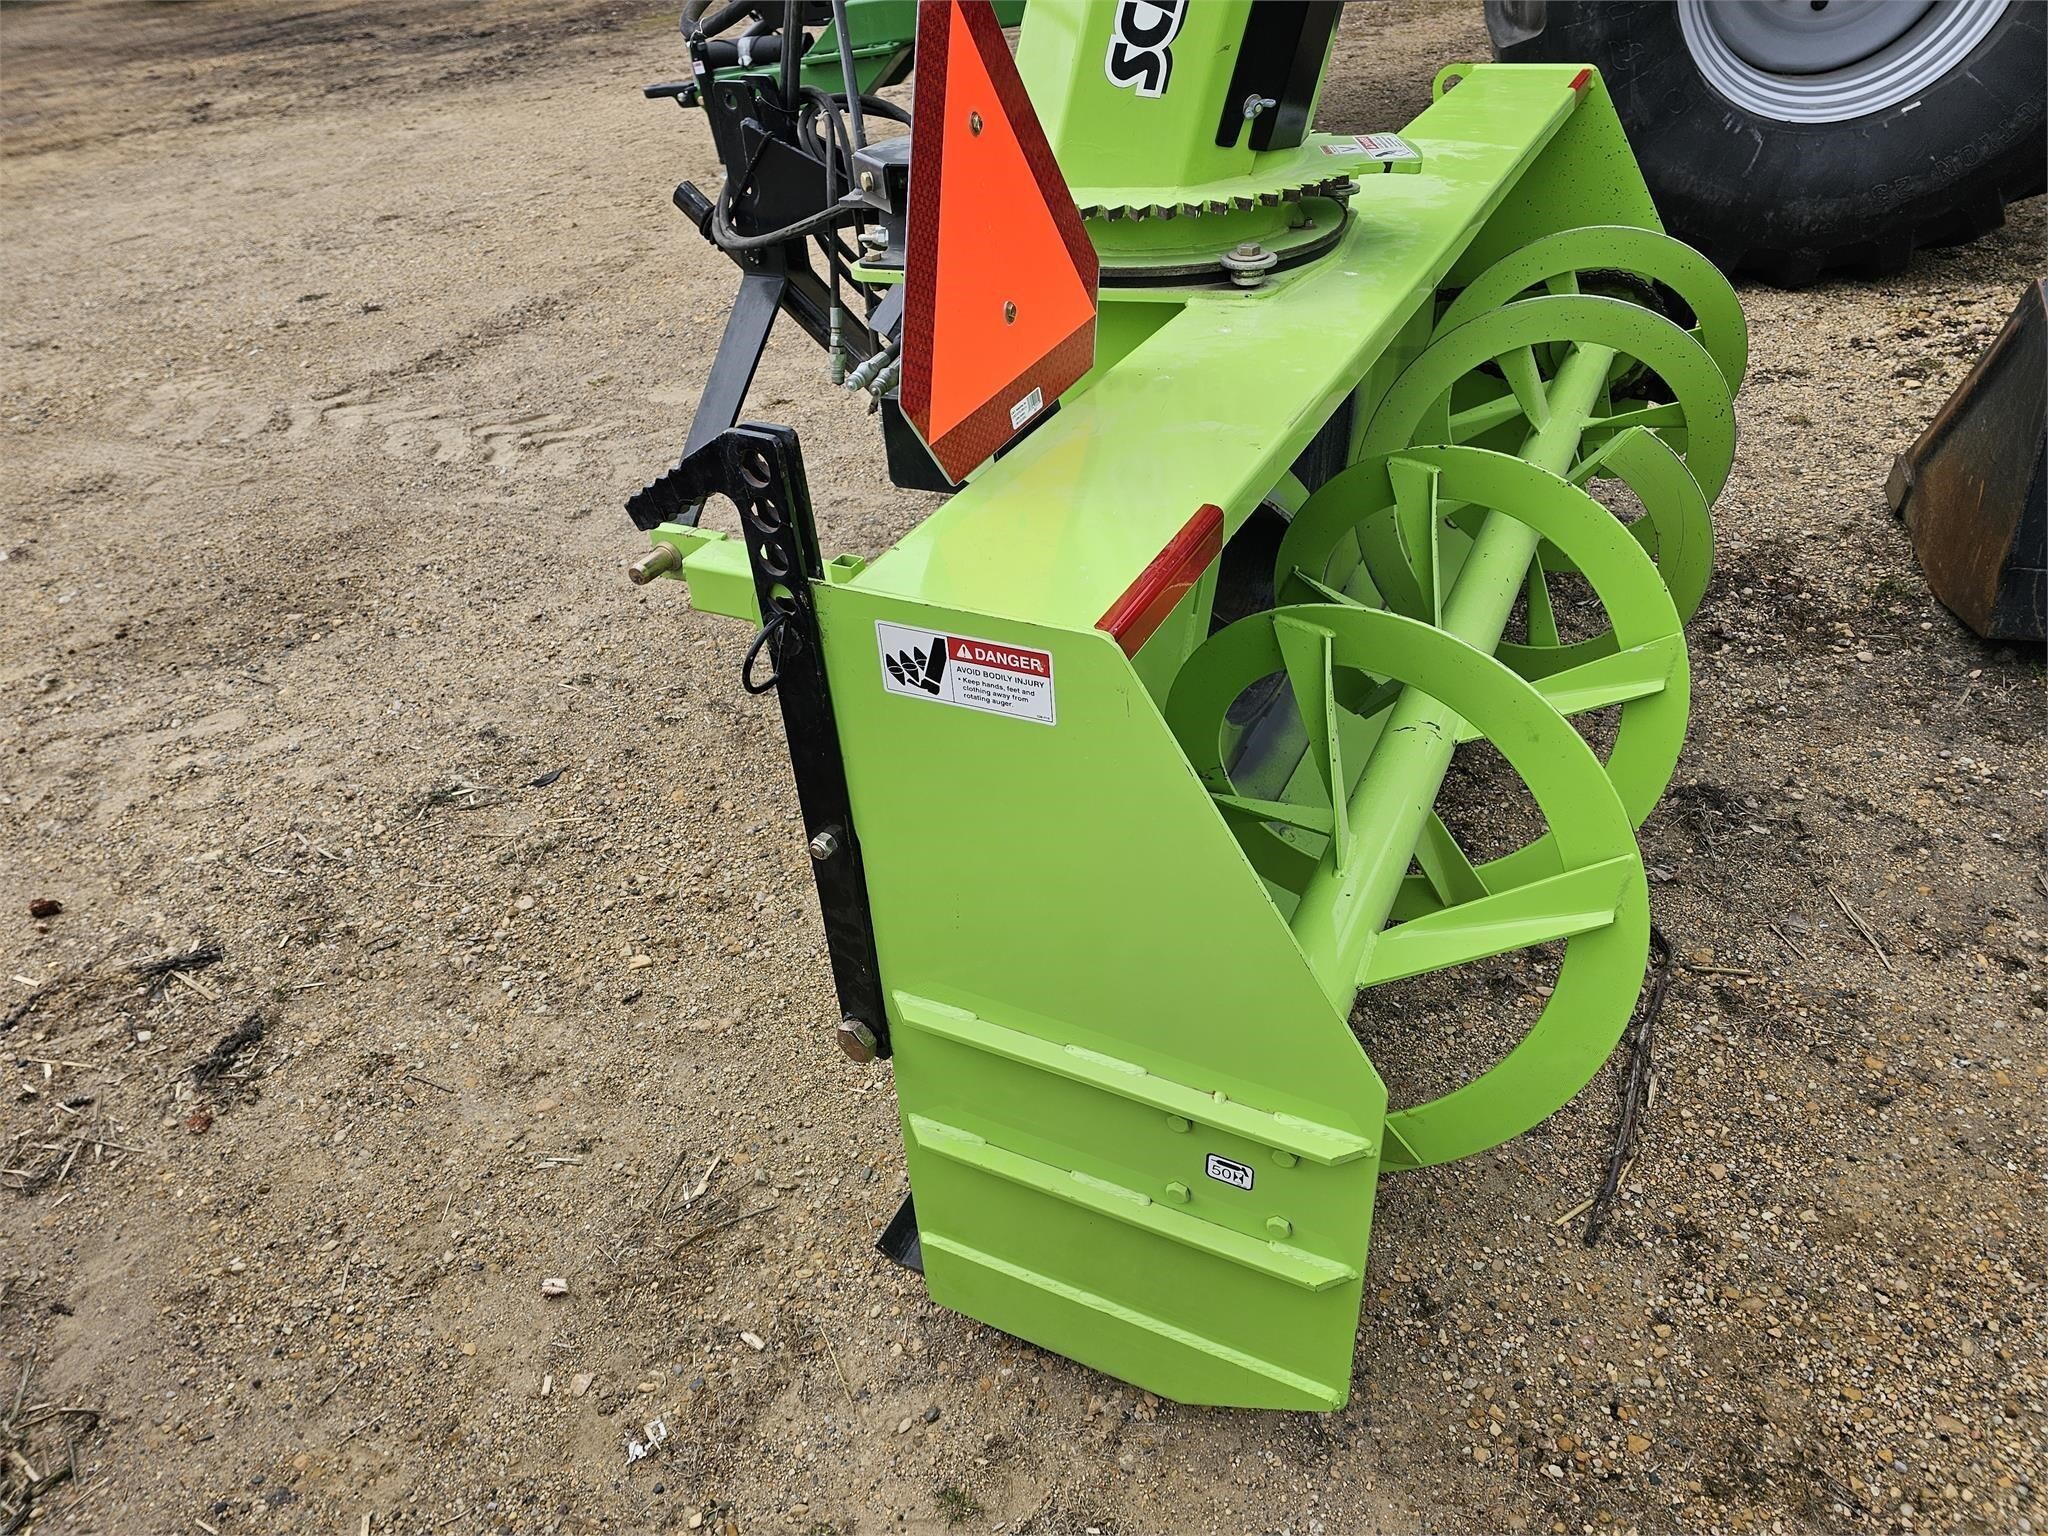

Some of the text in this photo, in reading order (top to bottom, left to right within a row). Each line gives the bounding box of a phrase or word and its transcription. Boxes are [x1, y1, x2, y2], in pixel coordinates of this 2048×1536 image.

[1109, 0, 1182, 95] SC
[975, 648, 1044, 672] DANGER
[956, 666, 1045, 689] AVOID BODILY INJURY
[962, 677, 1035, 697] Keep hands, feet and
[962, 684, 1029, 703] clothing away from
[963, 693, 1014, 708] rotating auger.
